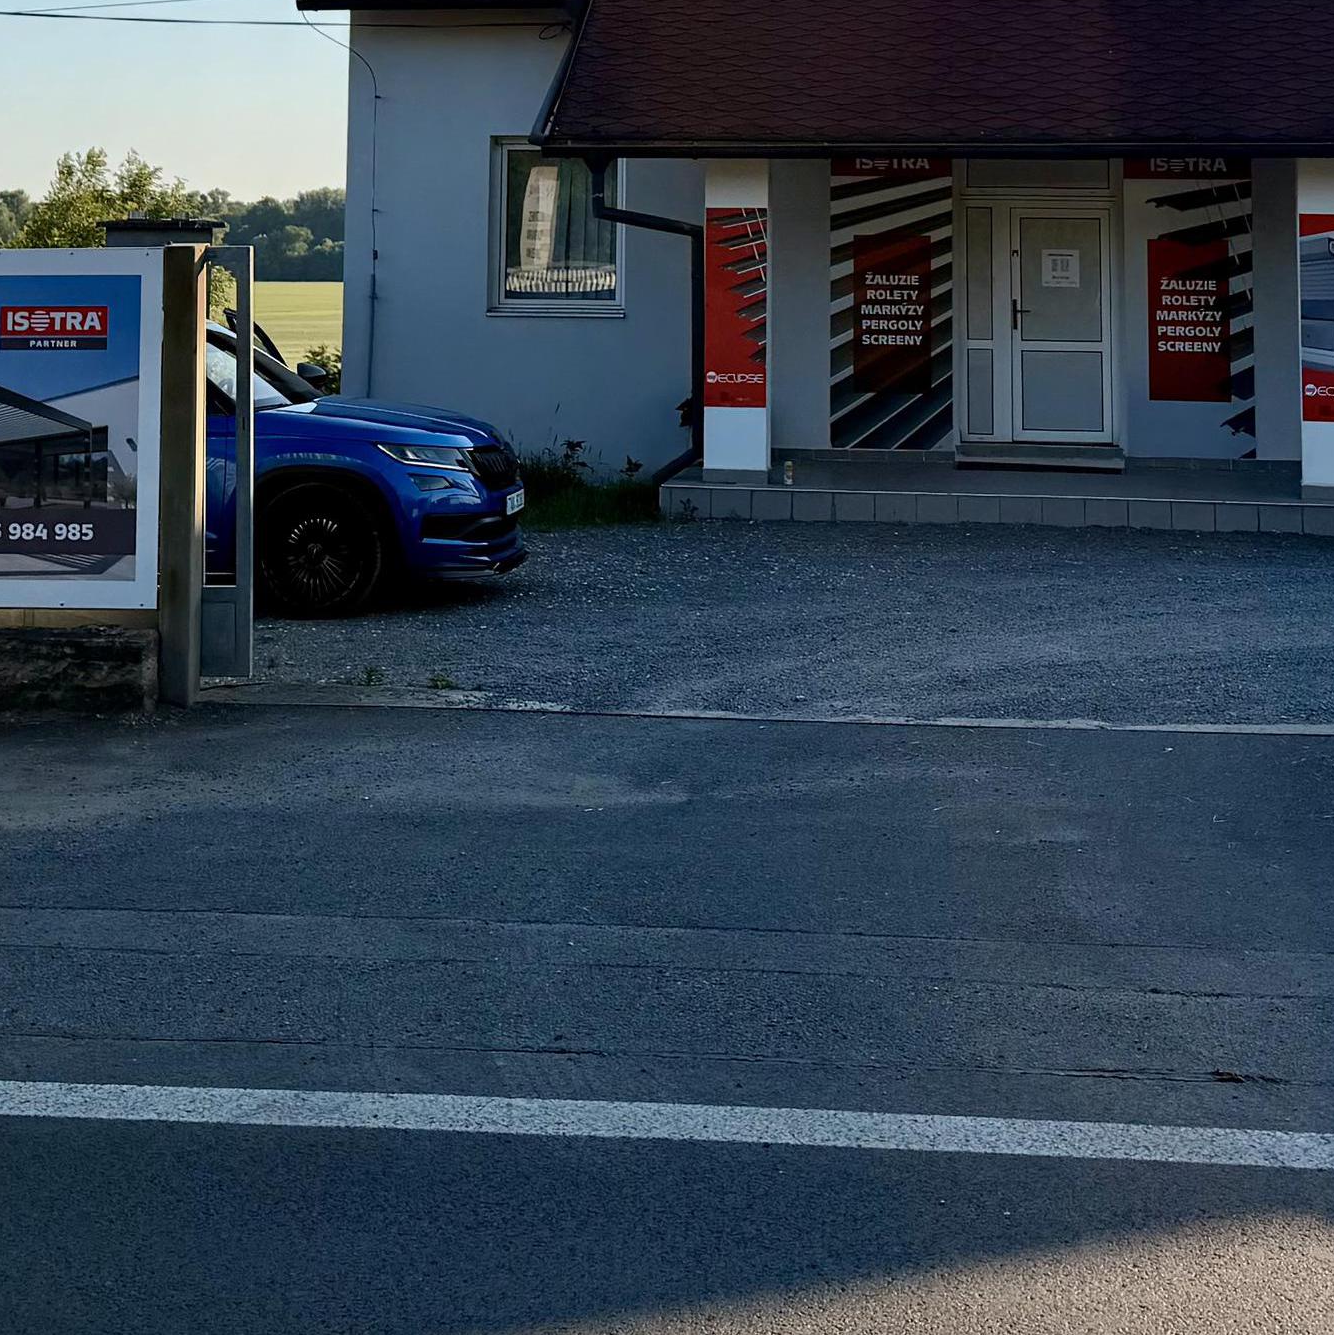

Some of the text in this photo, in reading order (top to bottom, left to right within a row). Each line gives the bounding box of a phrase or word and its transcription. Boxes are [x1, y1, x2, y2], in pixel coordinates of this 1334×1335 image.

[865, 271, 920, 286] ŽALUZIE
[1160, 276, 1217, 291] ŽALUZIE
[866, 289, 918, 301] ROLETY
[1161, 295, 1217, 306] ROLETY
[860, 302, 924, 316] MARKÝZY
[1156, 308, 1222, 322] MARKÝZY
[861, 320, 923, 331] PERGOLY
[1157, 326, 1222, 338] PERGOLY
[29, 339, 78, 348] PARTNER
[861, 335, 923, 346] SCREENY
[1157, 341, 1222, 353] SCREENY
[8, 523, 49, 542] 984
[54, 522, 95, 542] 985
